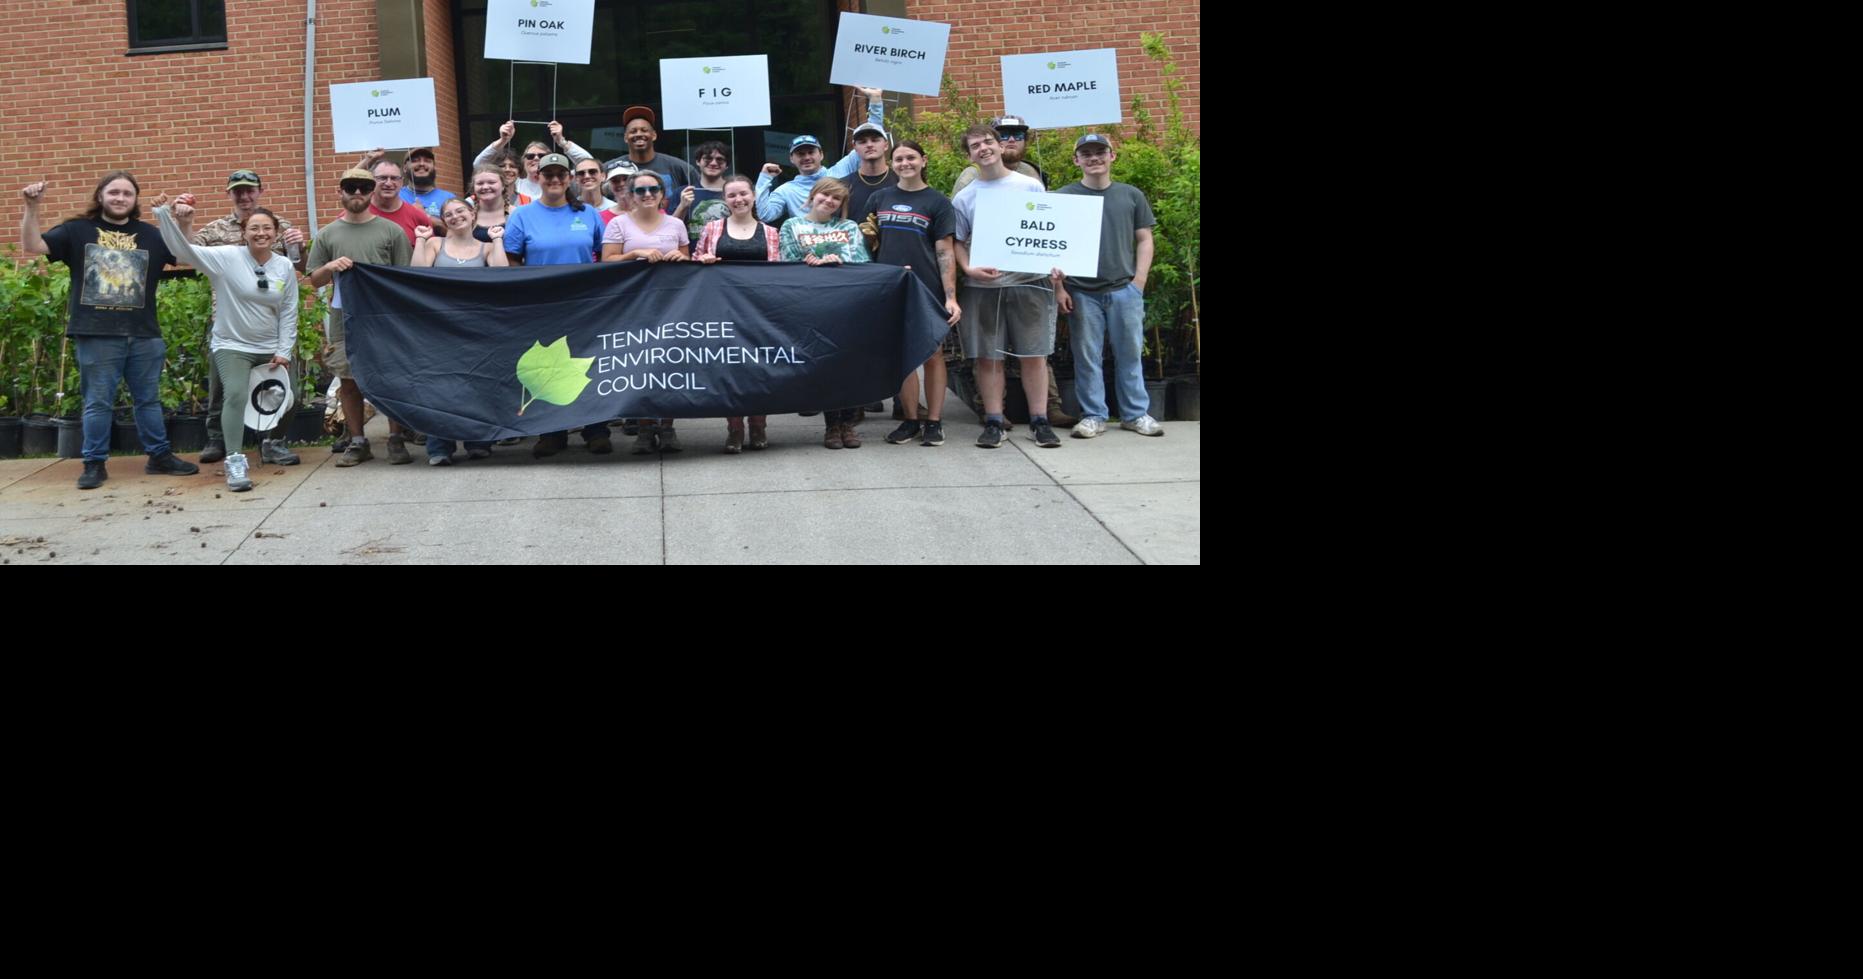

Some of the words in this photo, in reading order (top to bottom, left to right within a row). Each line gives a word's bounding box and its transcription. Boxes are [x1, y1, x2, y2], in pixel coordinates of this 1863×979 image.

[518, 19, 536, 28] PIN
[540, 20, 565, 30] OAK
[854, 43, 889, 56] RIVER
[890, 47, 926, 60] BIRCH
[1028, 84, 1051, 94] RED
[1054, 80, 1097, 92] MAPLE
[367, 107, 401, 118] PLUM
[1020, 220, 1056, 231] BALD
[1005, 236, 1068, 250] CYPRESS
[597, 321, 735, 351] TENNESSEE
[598, 346, 806, 374] ENVIRONMENTAL
[597, 372, 706, 397] COUNCIL
